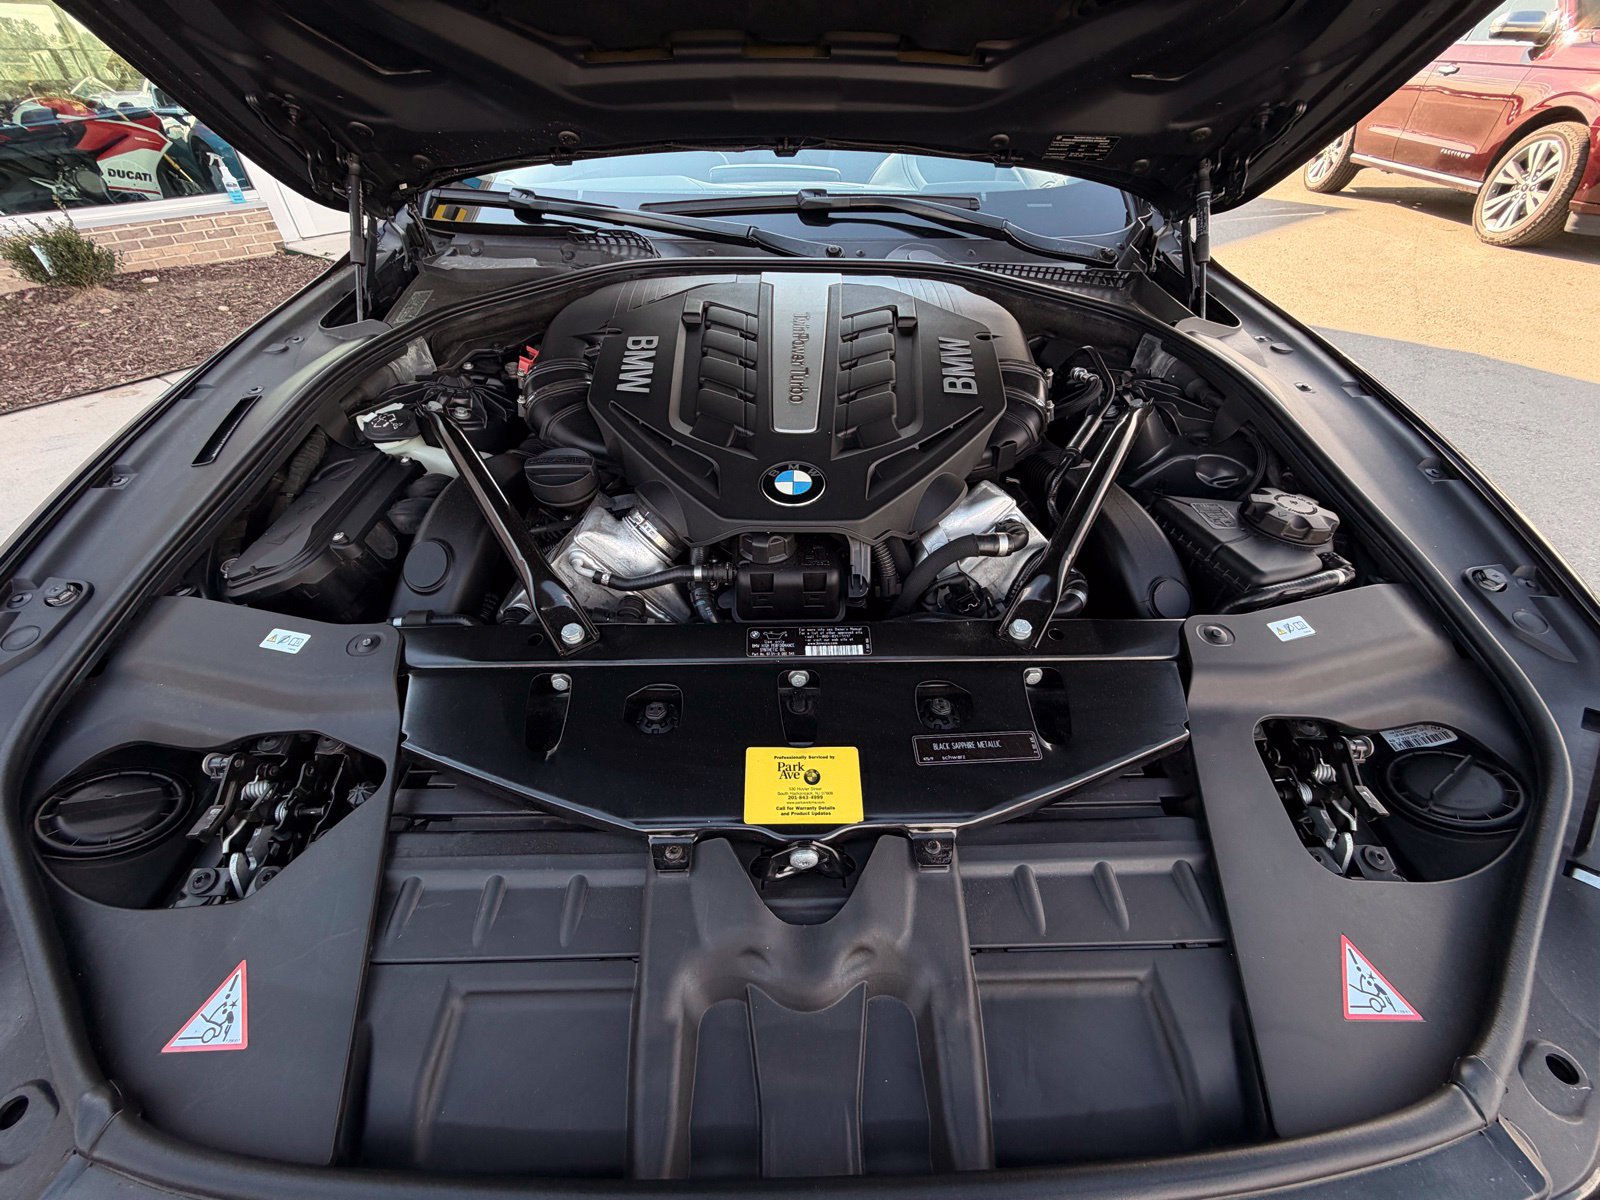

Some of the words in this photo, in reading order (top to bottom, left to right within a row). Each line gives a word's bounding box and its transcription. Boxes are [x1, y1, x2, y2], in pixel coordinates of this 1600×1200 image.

[107, 168, 153, 182] DUCATI
[616, 335, 660, 393] BMW
[938, 336, 978, 395] BMW
[768, 463, 821, 478] BMW
[932, 742, 950, 751] BLACK
[951, 741, 976, 750] SAPPHIRE
[976, 739, 1002, 749] METALLIC
[777, 762, 805, 772] Park
[779, 769, 800, 780] Ave
